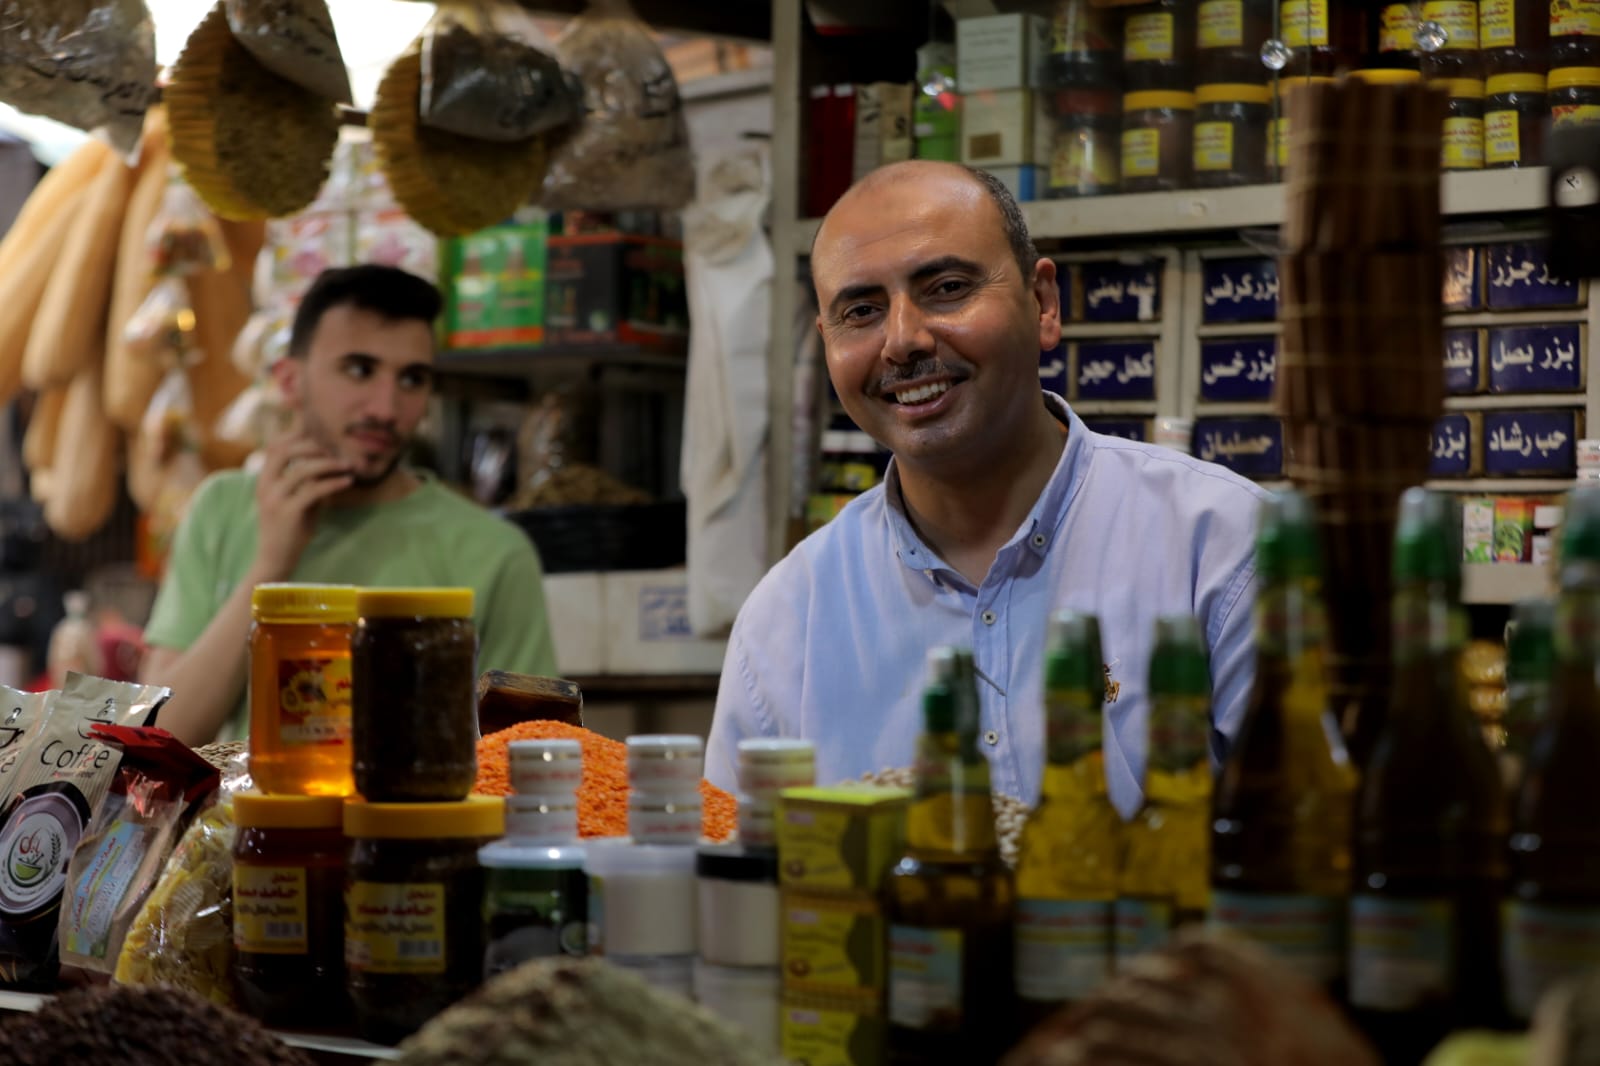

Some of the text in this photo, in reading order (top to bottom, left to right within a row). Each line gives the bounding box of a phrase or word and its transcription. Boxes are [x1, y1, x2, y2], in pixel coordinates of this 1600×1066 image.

[1492, 255, 1536, 288] جزر
[1204, 273, 1253, 305] كرفس
[1203, 350, 1246, 385] خس
[1491, 336, 1574, 374] بزر بصل
[1434, 425, 1467, 461] بزر
[1489, 420, 1533, 457] رشاد
[1535, 429, 1568, 458] حب
[40, 739, 110, 769] Coffee
